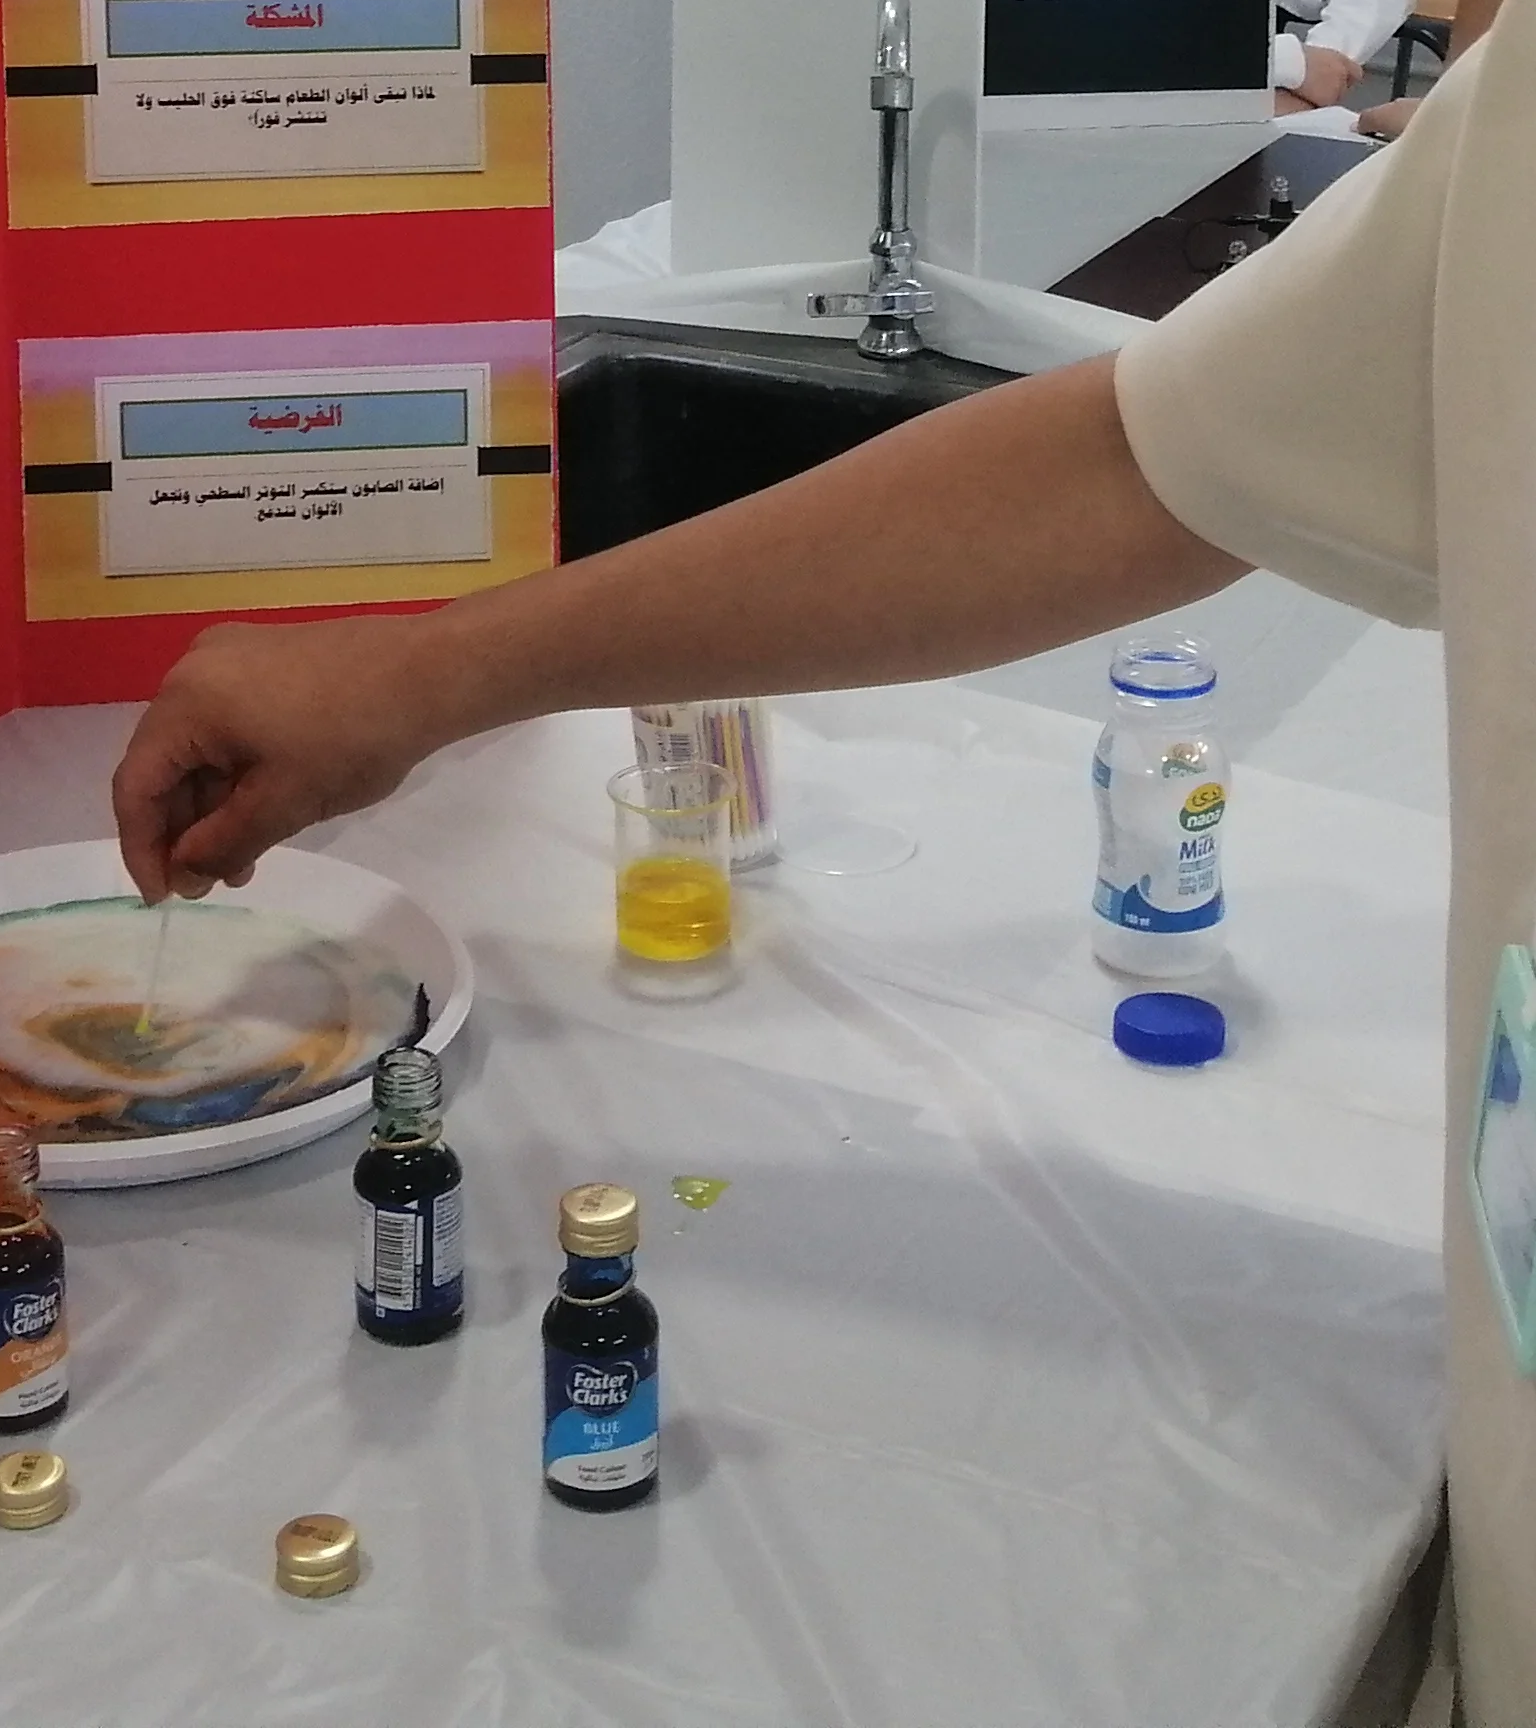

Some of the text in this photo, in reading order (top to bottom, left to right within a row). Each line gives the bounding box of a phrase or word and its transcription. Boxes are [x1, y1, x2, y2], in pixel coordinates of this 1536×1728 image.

[245, 2, 324, 29] المشكلة
[136, 92, 153, 110] ولا
[157, 91, 205, 109] الحليب
[210, 91, 236, 109] فوق
[240, 88, 281, 105] ساكنة
[285, 88, 330, 108] الطعام
[335, 83, 368, 107] ألوان
[283, 110, 327, 128] تنتشر
[248, 402, 342, 434] الفرضية
[149, 476, 445, 508] إضافة الصابون ستكسر التوتر السطحي وتجعل
[1179, 836, 1216, 861] Milk
[13, 1292, 59, 1319] Foster
[574, 1372, 628, 1389] Foster
[572, 1386, 628, 1406] Clark's
[583, 1420, 621, 1435] BLUE
